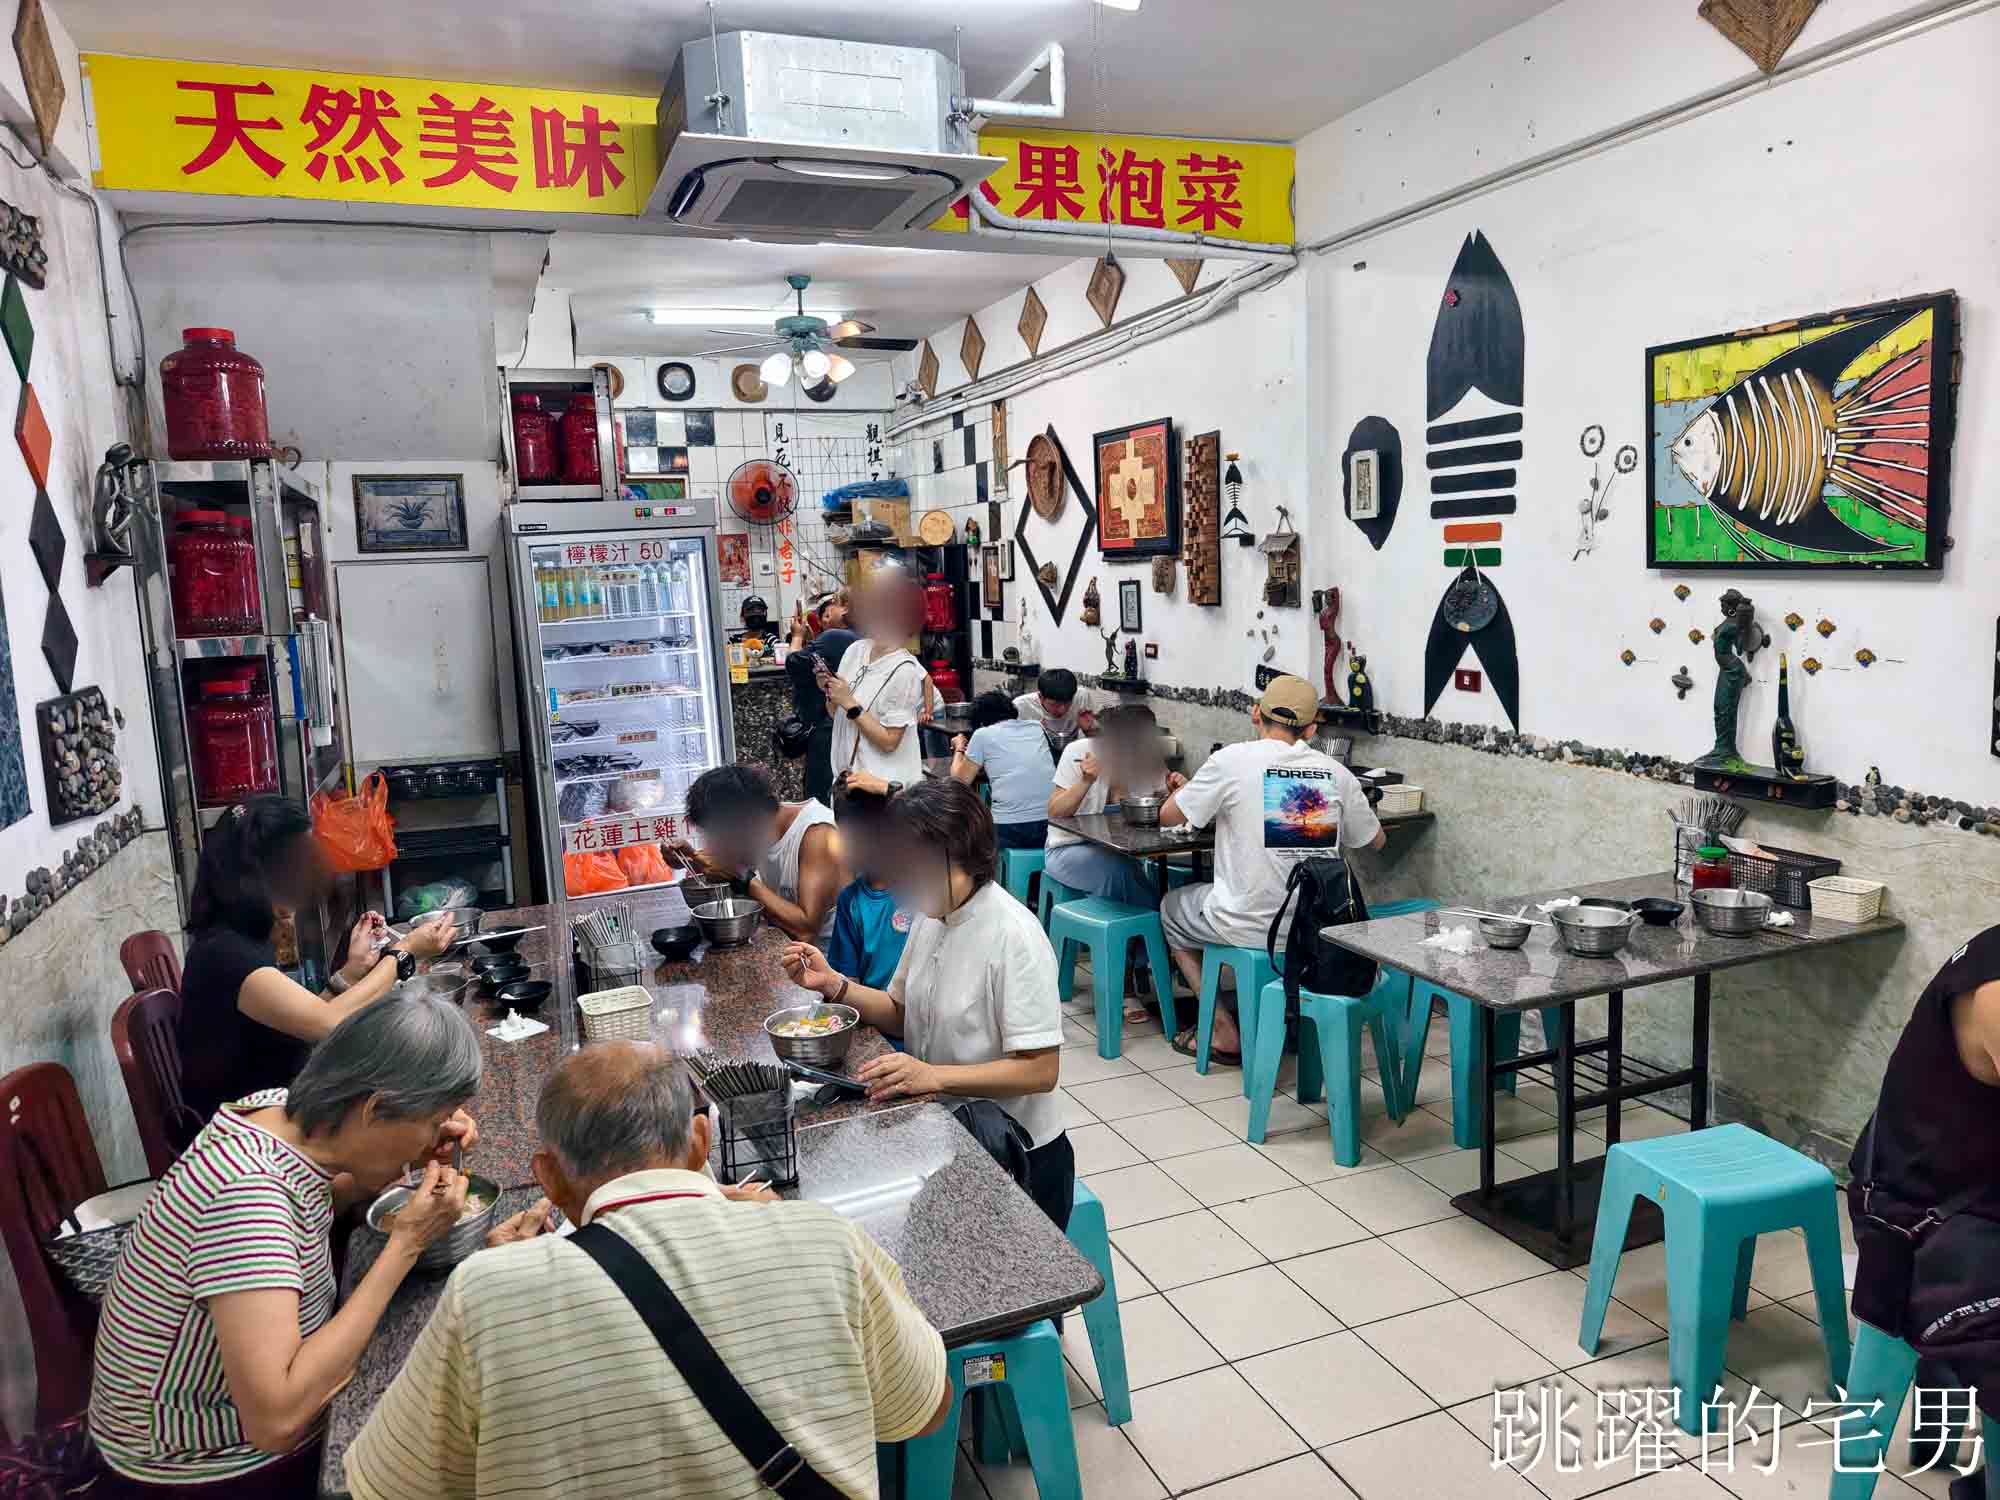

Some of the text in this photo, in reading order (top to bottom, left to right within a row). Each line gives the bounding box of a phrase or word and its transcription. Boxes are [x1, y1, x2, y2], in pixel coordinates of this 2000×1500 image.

[175, 80, 625, 198] 天然美味
[566, 543, 630, 565] 檸檬汁
[1266, 768, 1332, 781] FOREST
